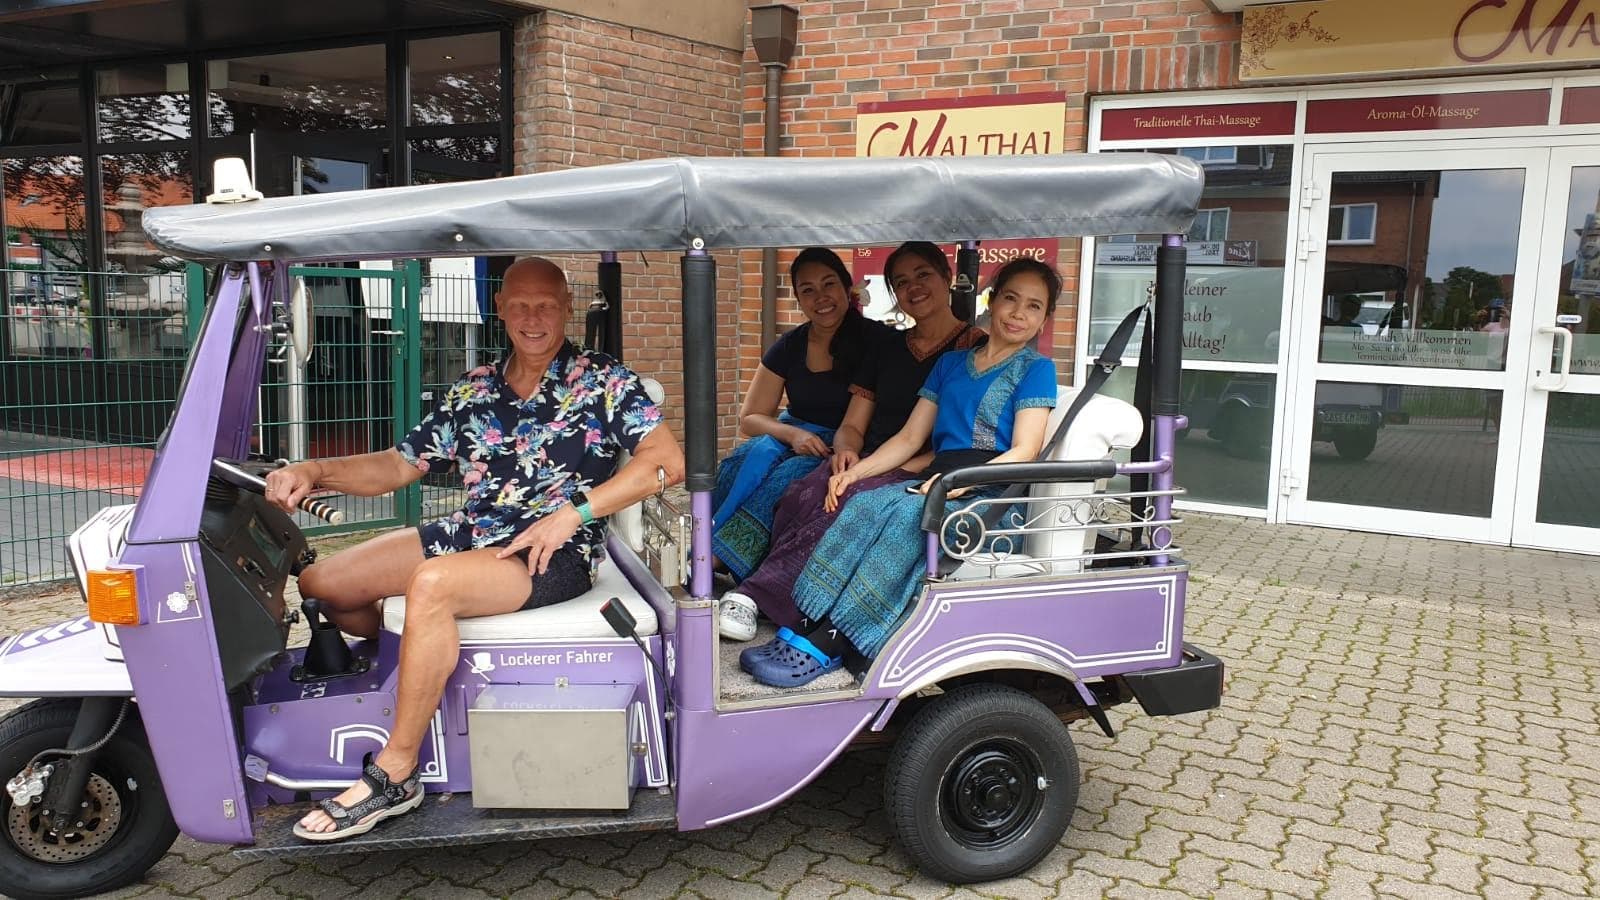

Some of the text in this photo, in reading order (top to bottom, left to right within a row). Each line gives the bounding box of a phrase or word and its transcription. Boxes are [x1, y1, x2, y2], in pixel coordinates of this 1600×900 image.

[1133, 114, 1261, 128] Traditionelle Thai-Massage
[1367, 105, 1480, 120] Aroma-Öl-Massage
[977, 131, 1051, 156] THAI
[1184, 280, 1227, 297] leiner
[1183, 305, 1212, 322] aub
[1401, 330, 1472, 345] Willkommen
[500, 650, 614, 667] Lockerer Fahrer
